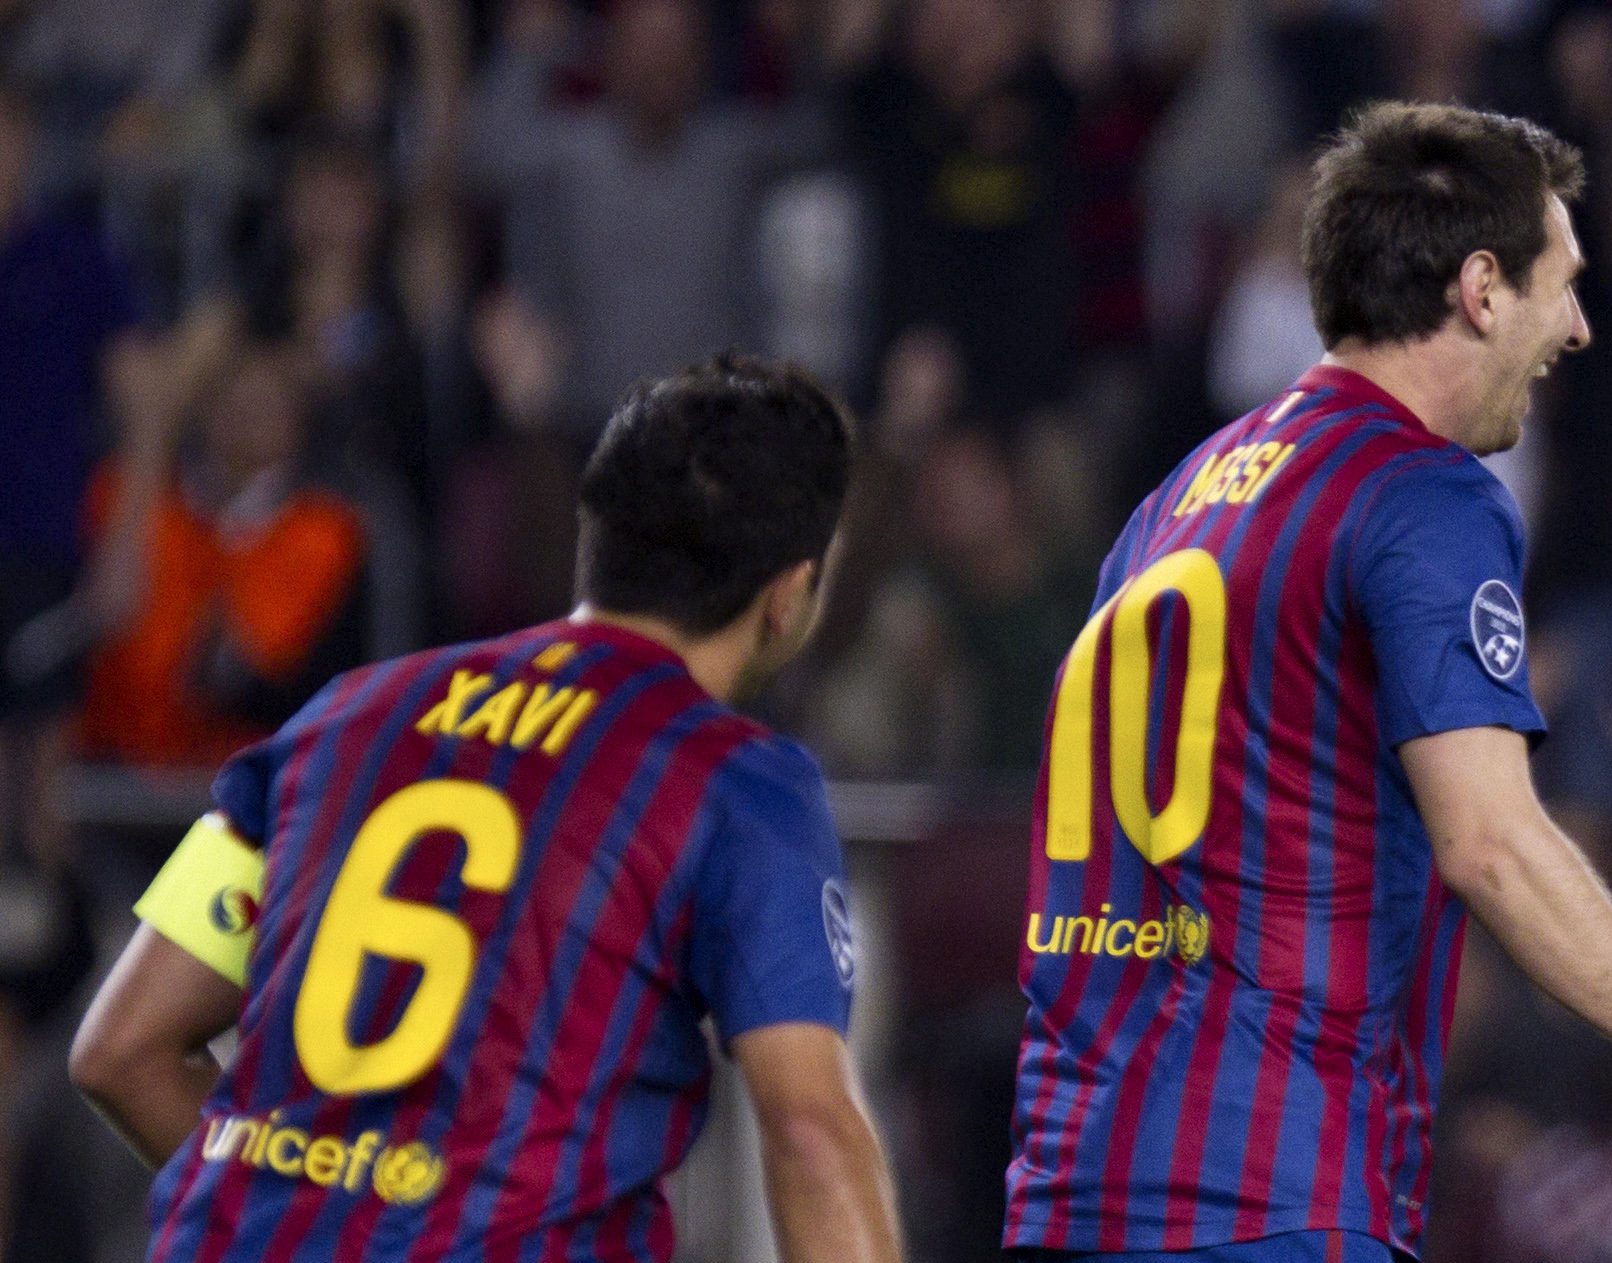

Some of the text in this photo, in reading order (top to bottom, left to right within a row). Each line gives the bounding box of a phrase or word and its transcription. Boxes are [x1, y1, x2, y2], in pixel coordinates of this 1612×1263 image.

[415, 669, 597, 757] XAVI
[1045, 548, 1227, 866] 10
[292, 777, 523, 1096] 6
[1026, 903, 1177, 960] unicef
[202, 1108, 383, 1191] unicef
